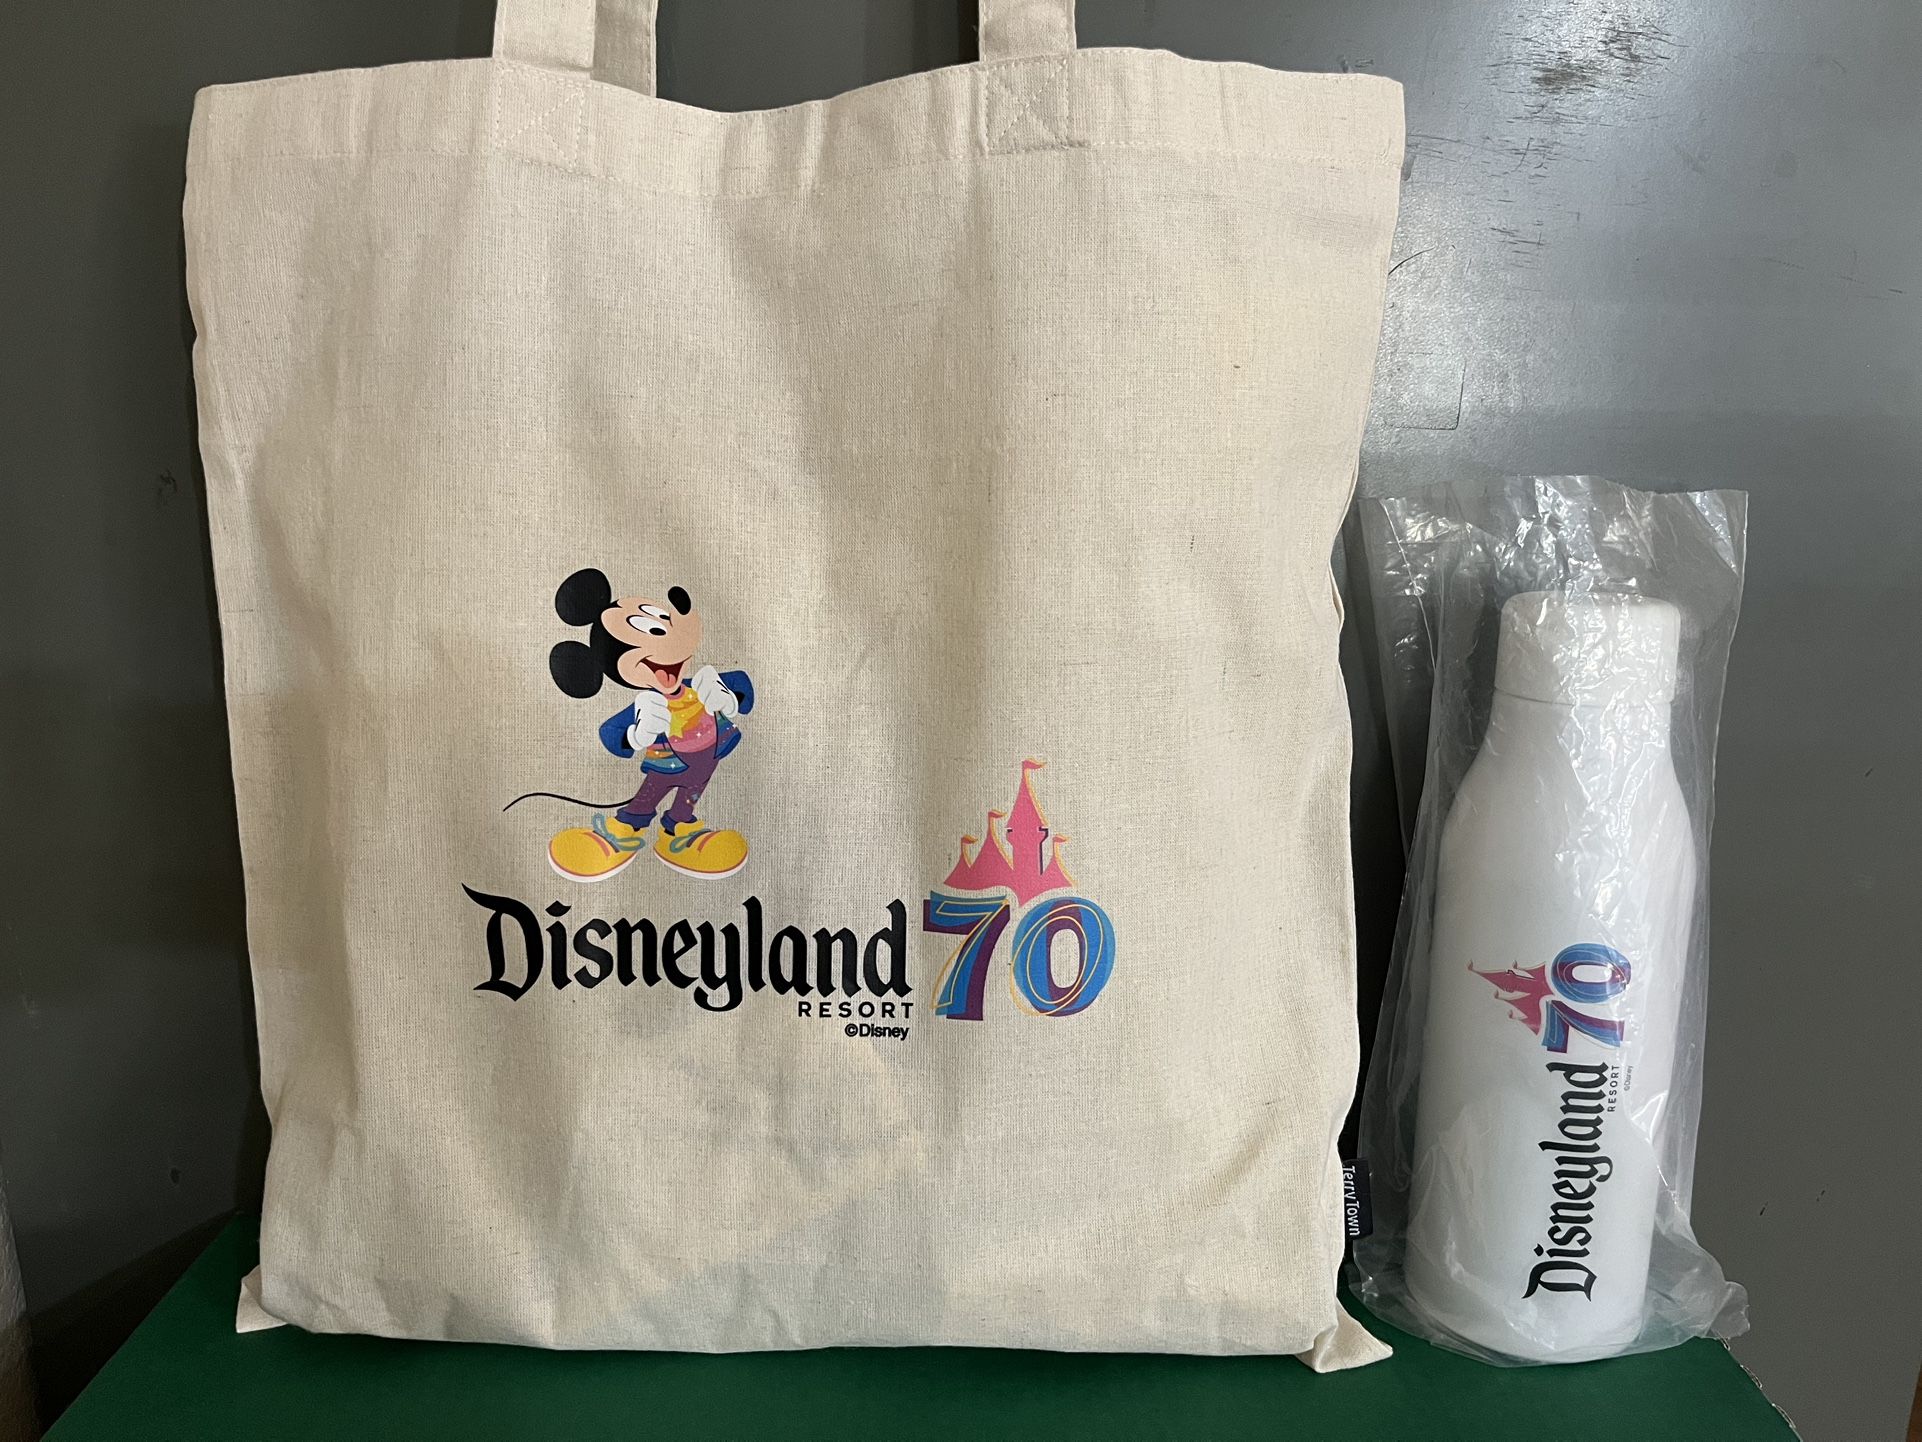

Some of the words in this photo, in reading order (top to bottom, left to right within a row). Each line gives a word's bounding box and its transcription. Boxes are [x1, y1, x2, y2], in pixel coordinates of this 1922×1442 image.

[462, 883, 912, 1012] Disneyland
[923, 890, 1116, 1021] 70
[1542, 943, 1632, 1054] 70
[798, 1001, 914, 1019] RESORT
[1607, 1065, 1620, 1112] RESORT
[1521, 1062, 1613, 1302] Disneyland
